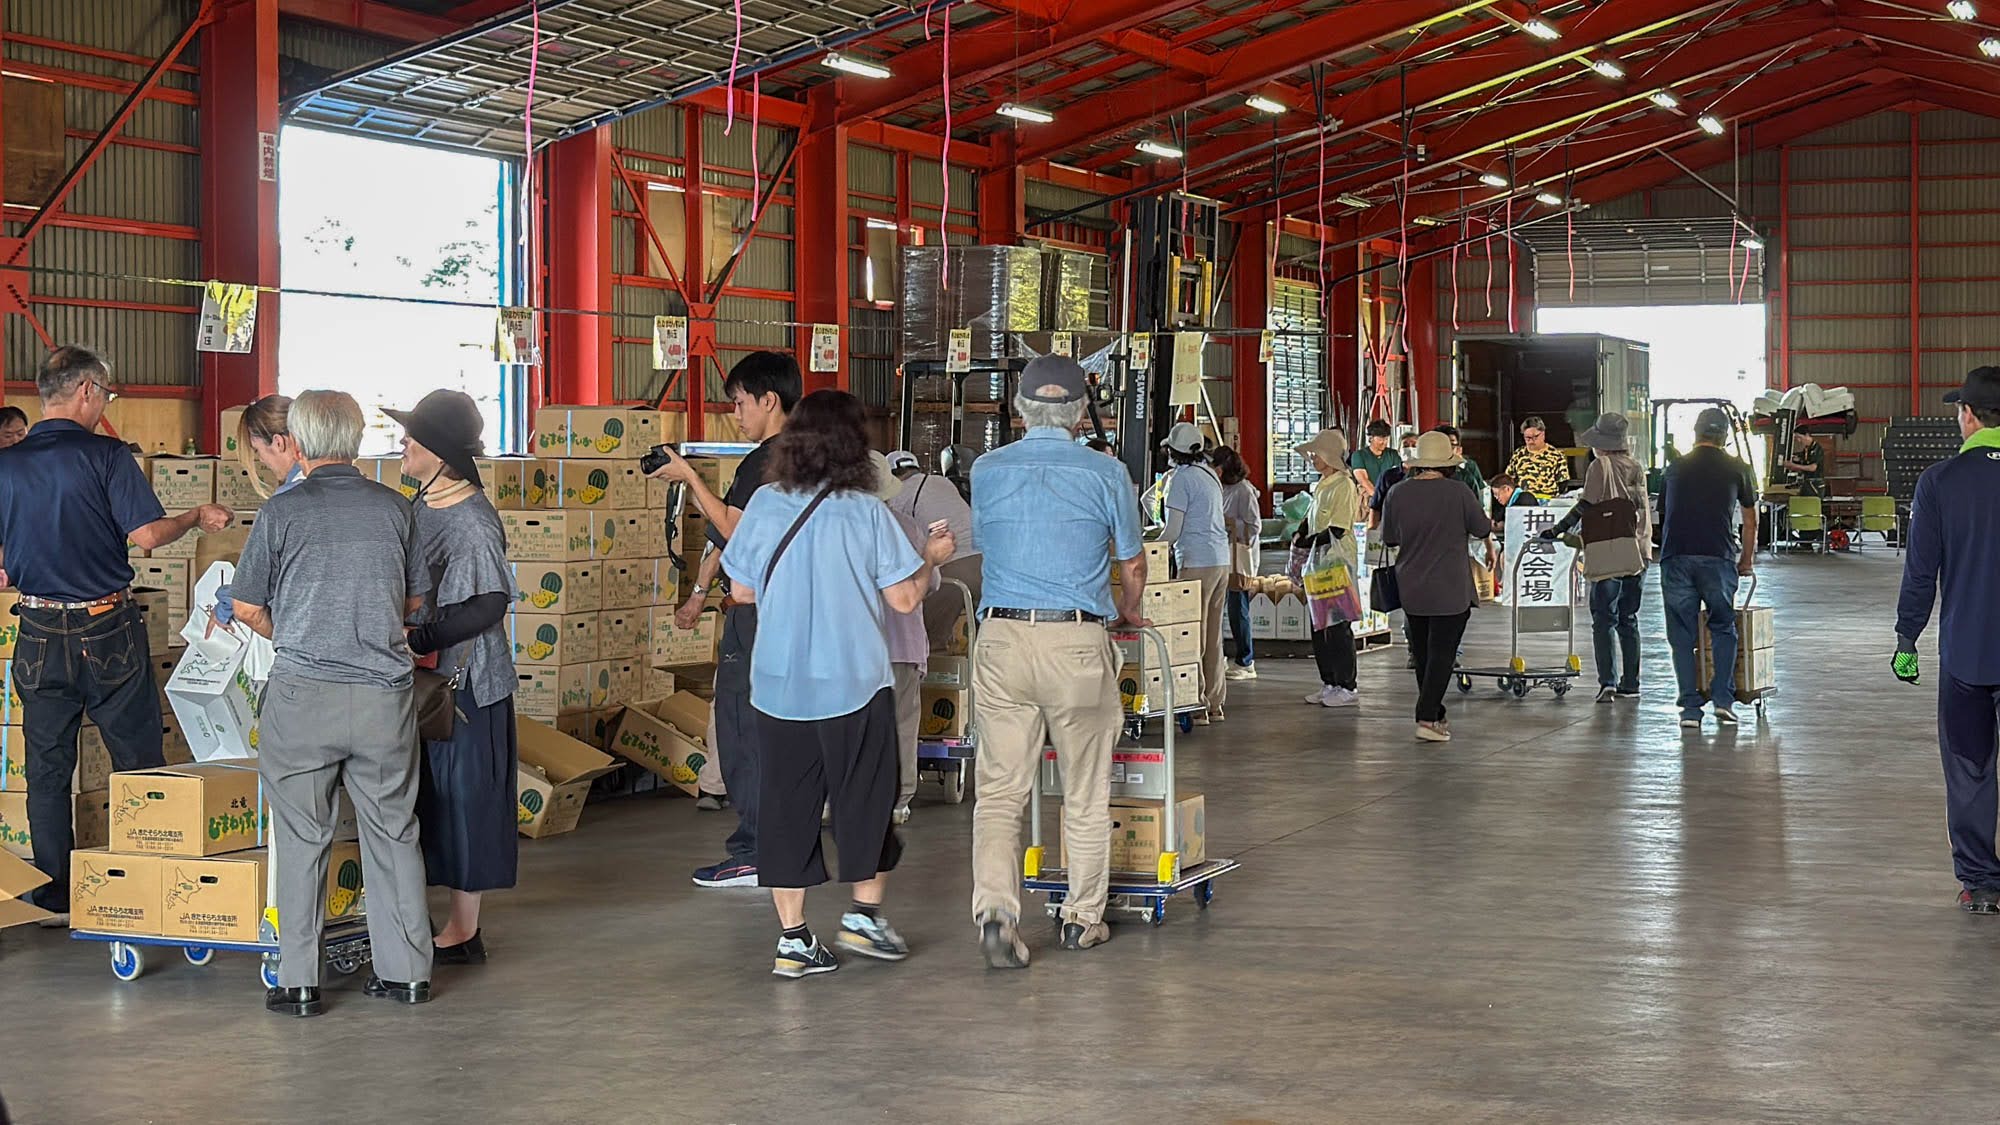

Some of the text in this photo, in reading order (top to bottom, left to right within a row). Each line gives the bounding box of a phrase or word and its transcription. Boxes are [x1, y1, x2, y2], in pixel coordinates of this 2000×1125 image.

[539, 431, 593, 449] ひまわすいか
[230, 796, 249, 809] 北竜
[127, 828, 138, 837] JA
[87, 905, 98, 913] JA
[179, 912, 191, 920] JA
